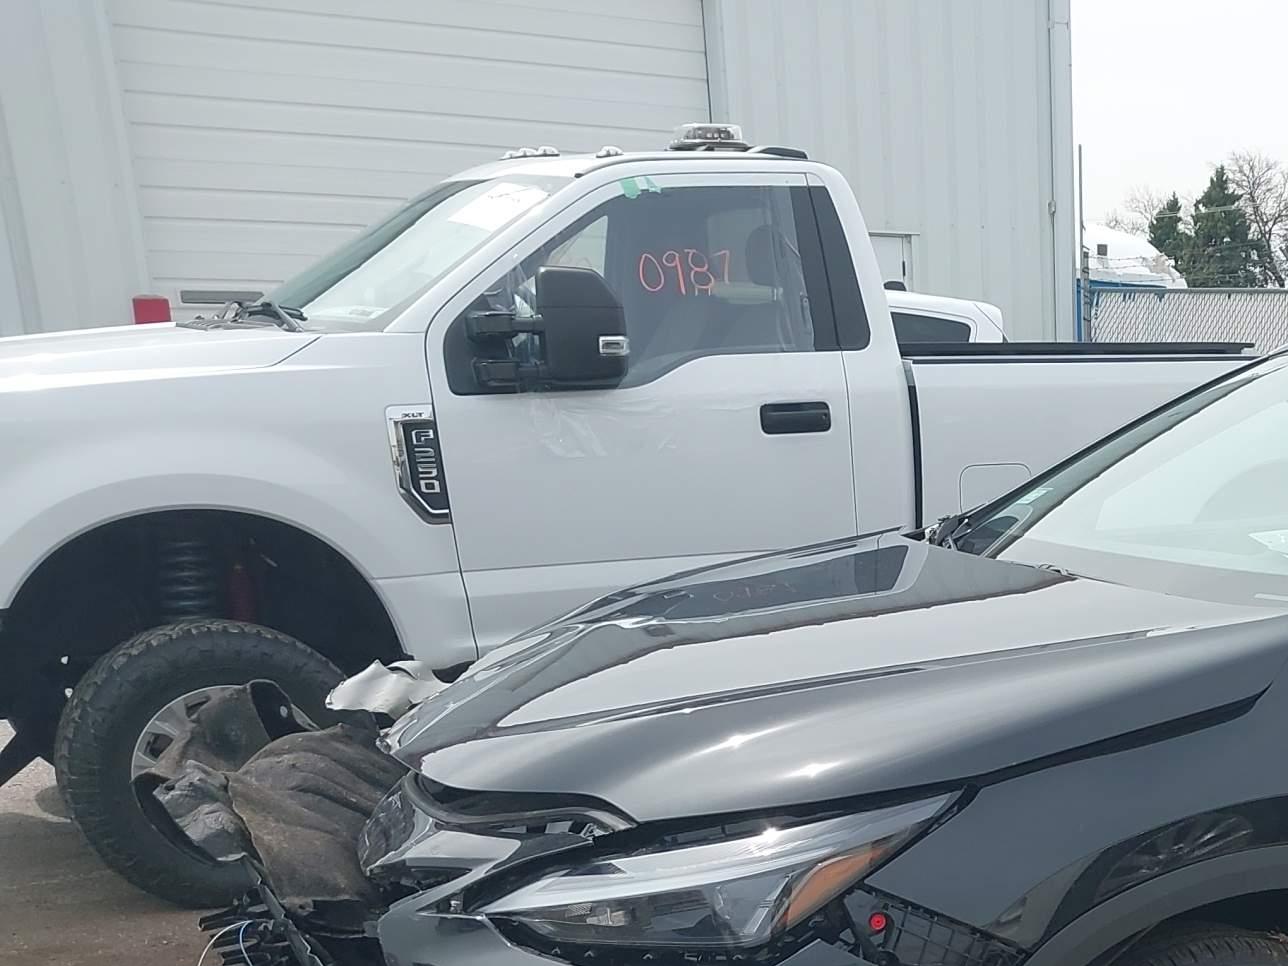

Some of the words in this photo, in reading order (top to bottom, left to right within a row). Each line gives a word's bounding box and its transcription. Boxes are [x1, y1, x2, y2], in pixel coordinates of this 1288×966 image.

[640, 248, 730, 296] 0987
[401, 411, 424, 419] XLT
[411, 429, 440, 493] F250
